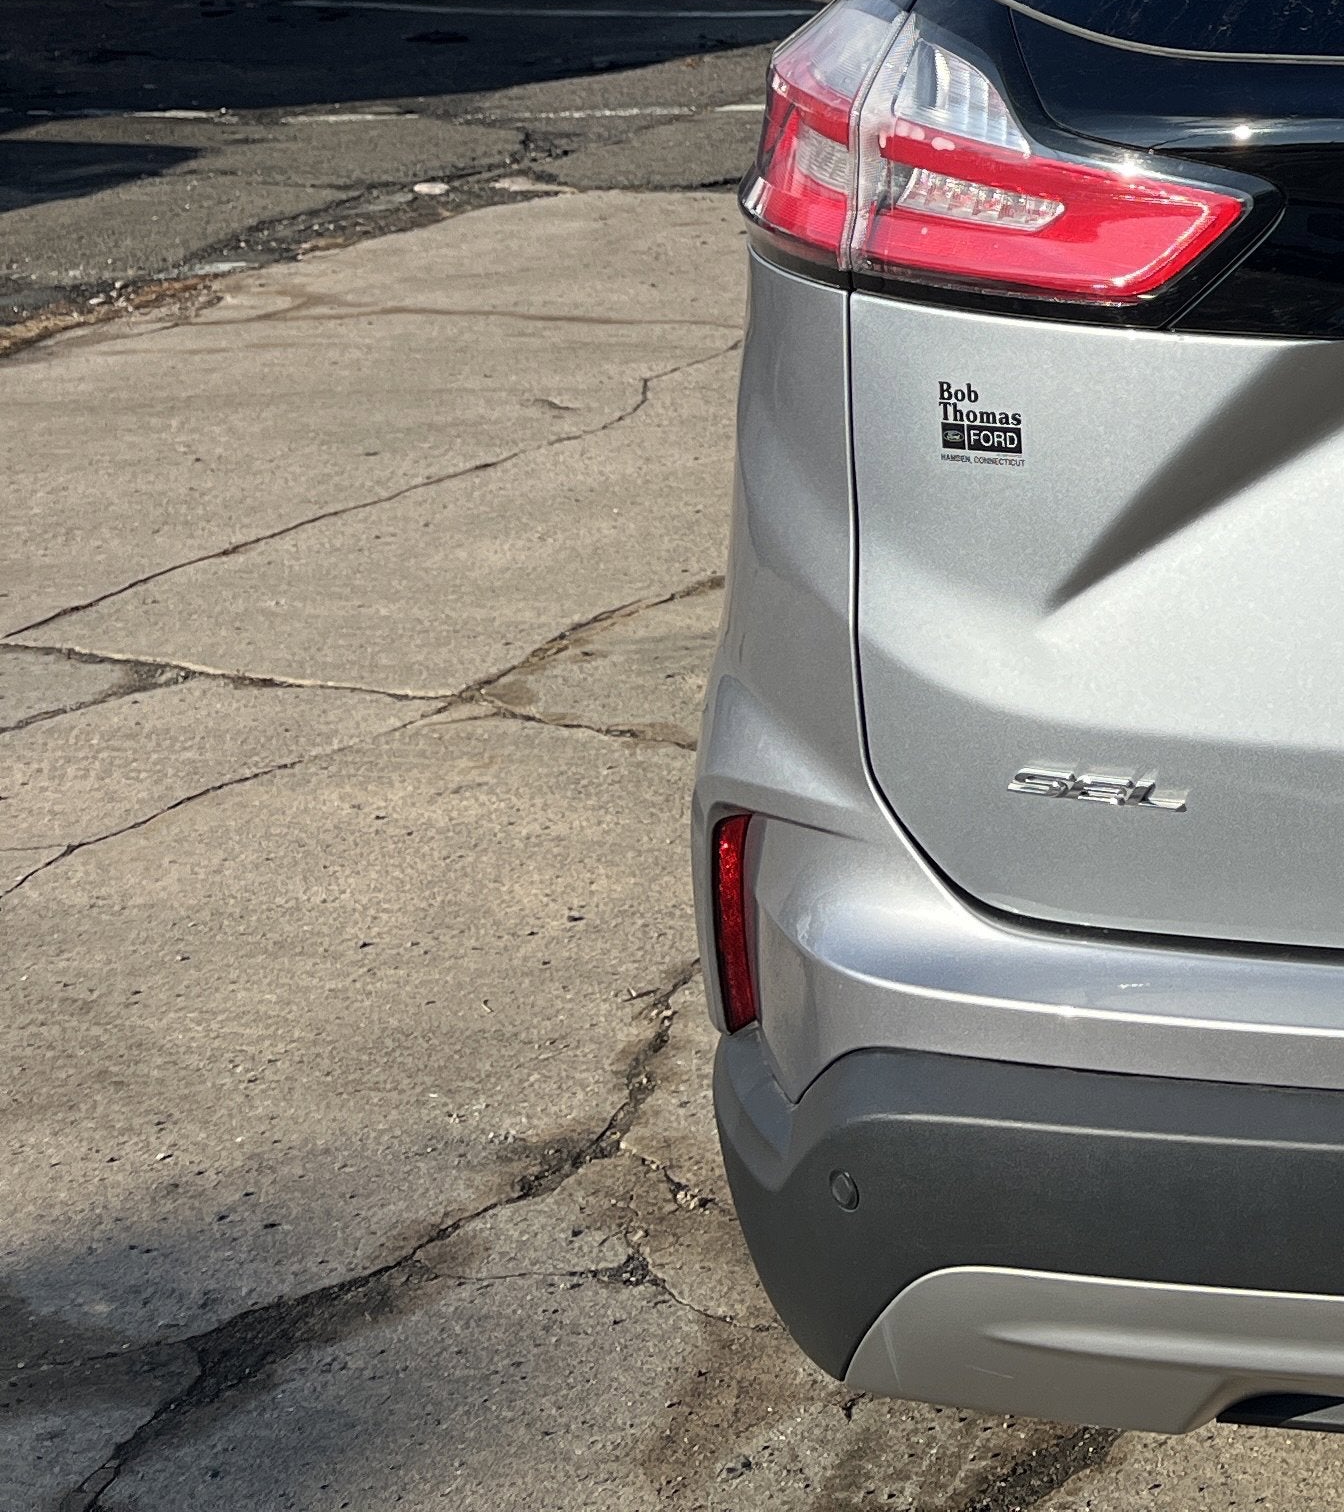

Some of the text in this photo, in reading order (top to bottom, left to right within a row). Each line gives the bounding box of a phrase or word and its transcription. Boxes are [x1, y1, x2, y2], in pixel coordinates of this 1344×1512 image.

[938, 380, 979, 403] Bob
[938, 401, 1022, 426] Thomas
[969, 430, 1018, 448] FORD
[973, 455, 1026, 468] CONNECTICUT
[1007, 767, 1188, 813] SEL
